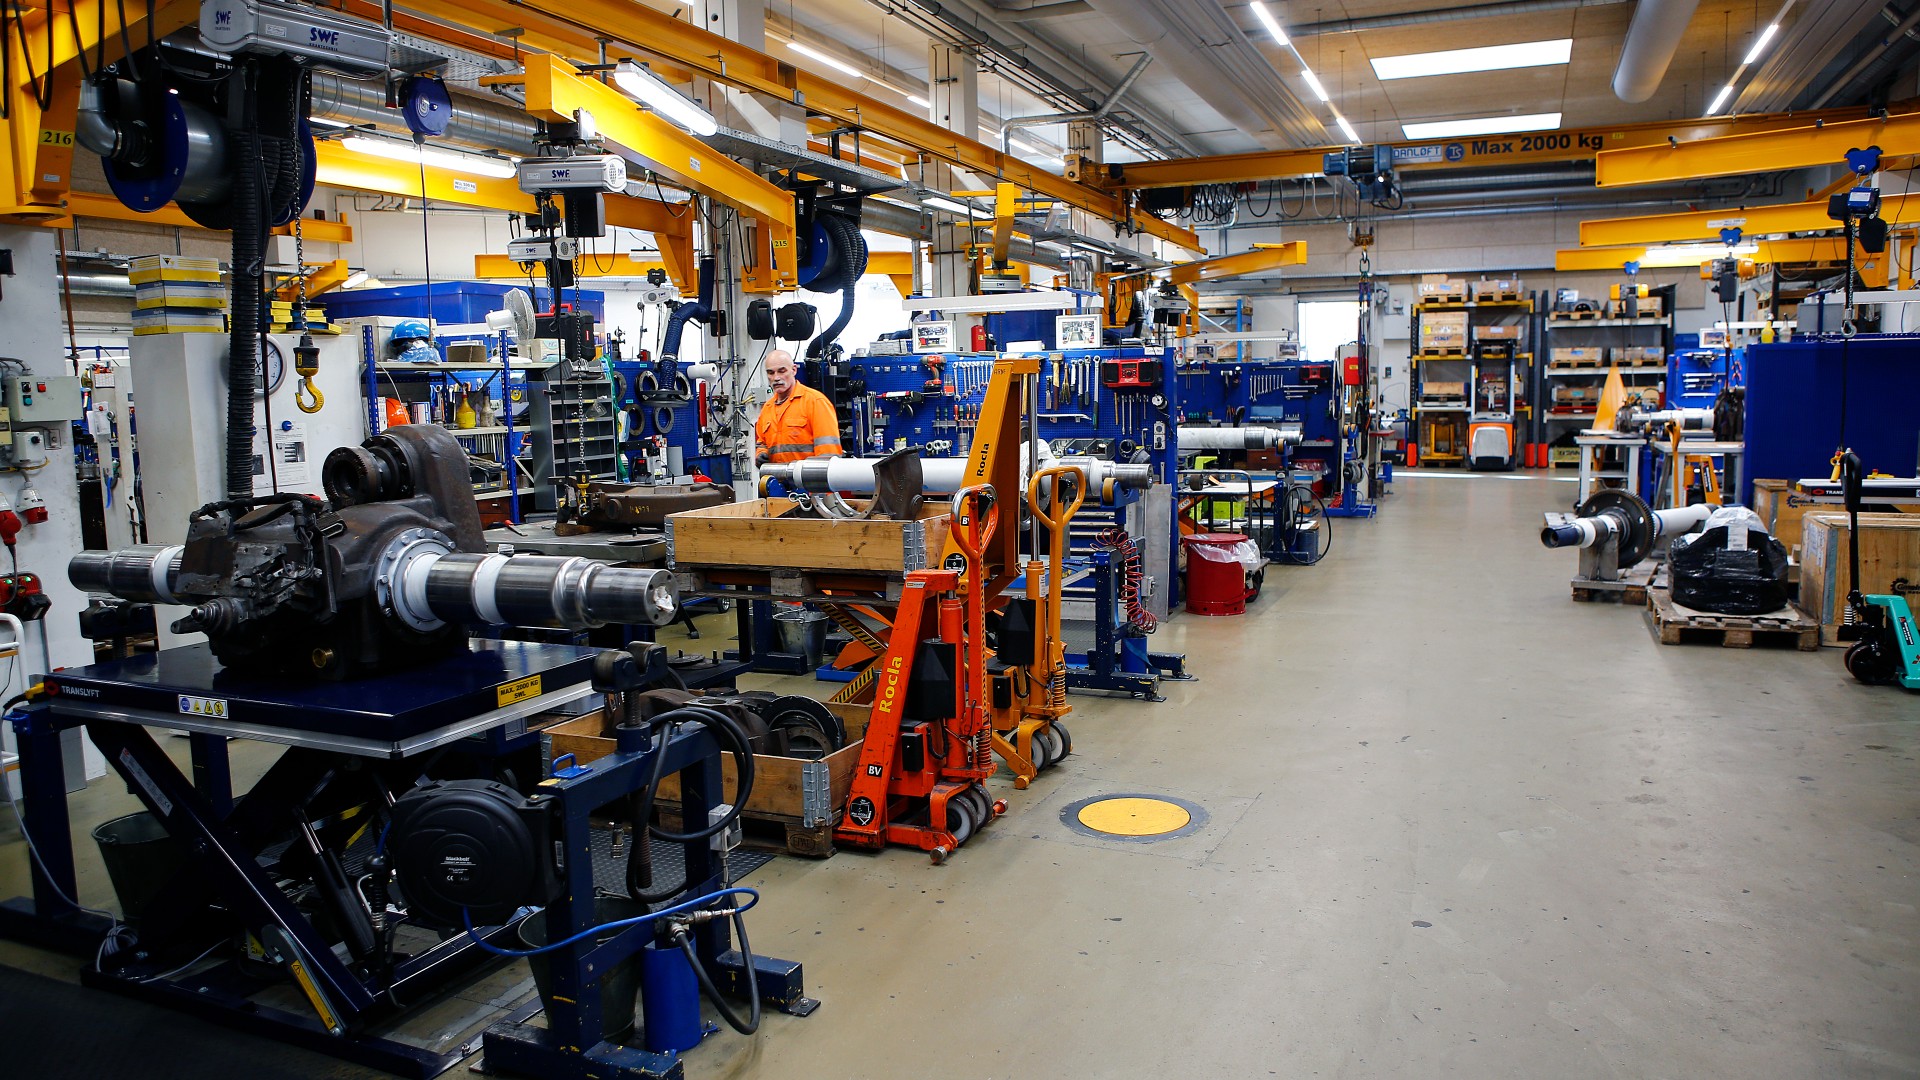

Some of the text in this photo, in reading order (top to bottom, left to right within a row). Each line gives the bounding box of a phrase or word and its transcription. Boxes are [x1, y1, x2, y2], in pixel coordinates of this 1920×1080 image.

[215, 10, 232, 25] SWF
[309, 27, 340, 45] SWF
[43, 131, 72, 145] 216
[1471, 140, 1514, 156] Max
[1520, 134, 1571, 151] 2000
[1578, 133, 1604, 150] kg
[551, 169, 570, 178] SWF
[976, 443, 990, 477] Rocla
[962, 516, 970, 525] B
[61, 685, 100, 698] TRANSLYFT
[500, 679, 539, 696] MAX. 2000 KG
[879, 656, 903, 714] Rocla
[514, 690, 527, 699] SWL
[868, 765, 882, 776] BV
